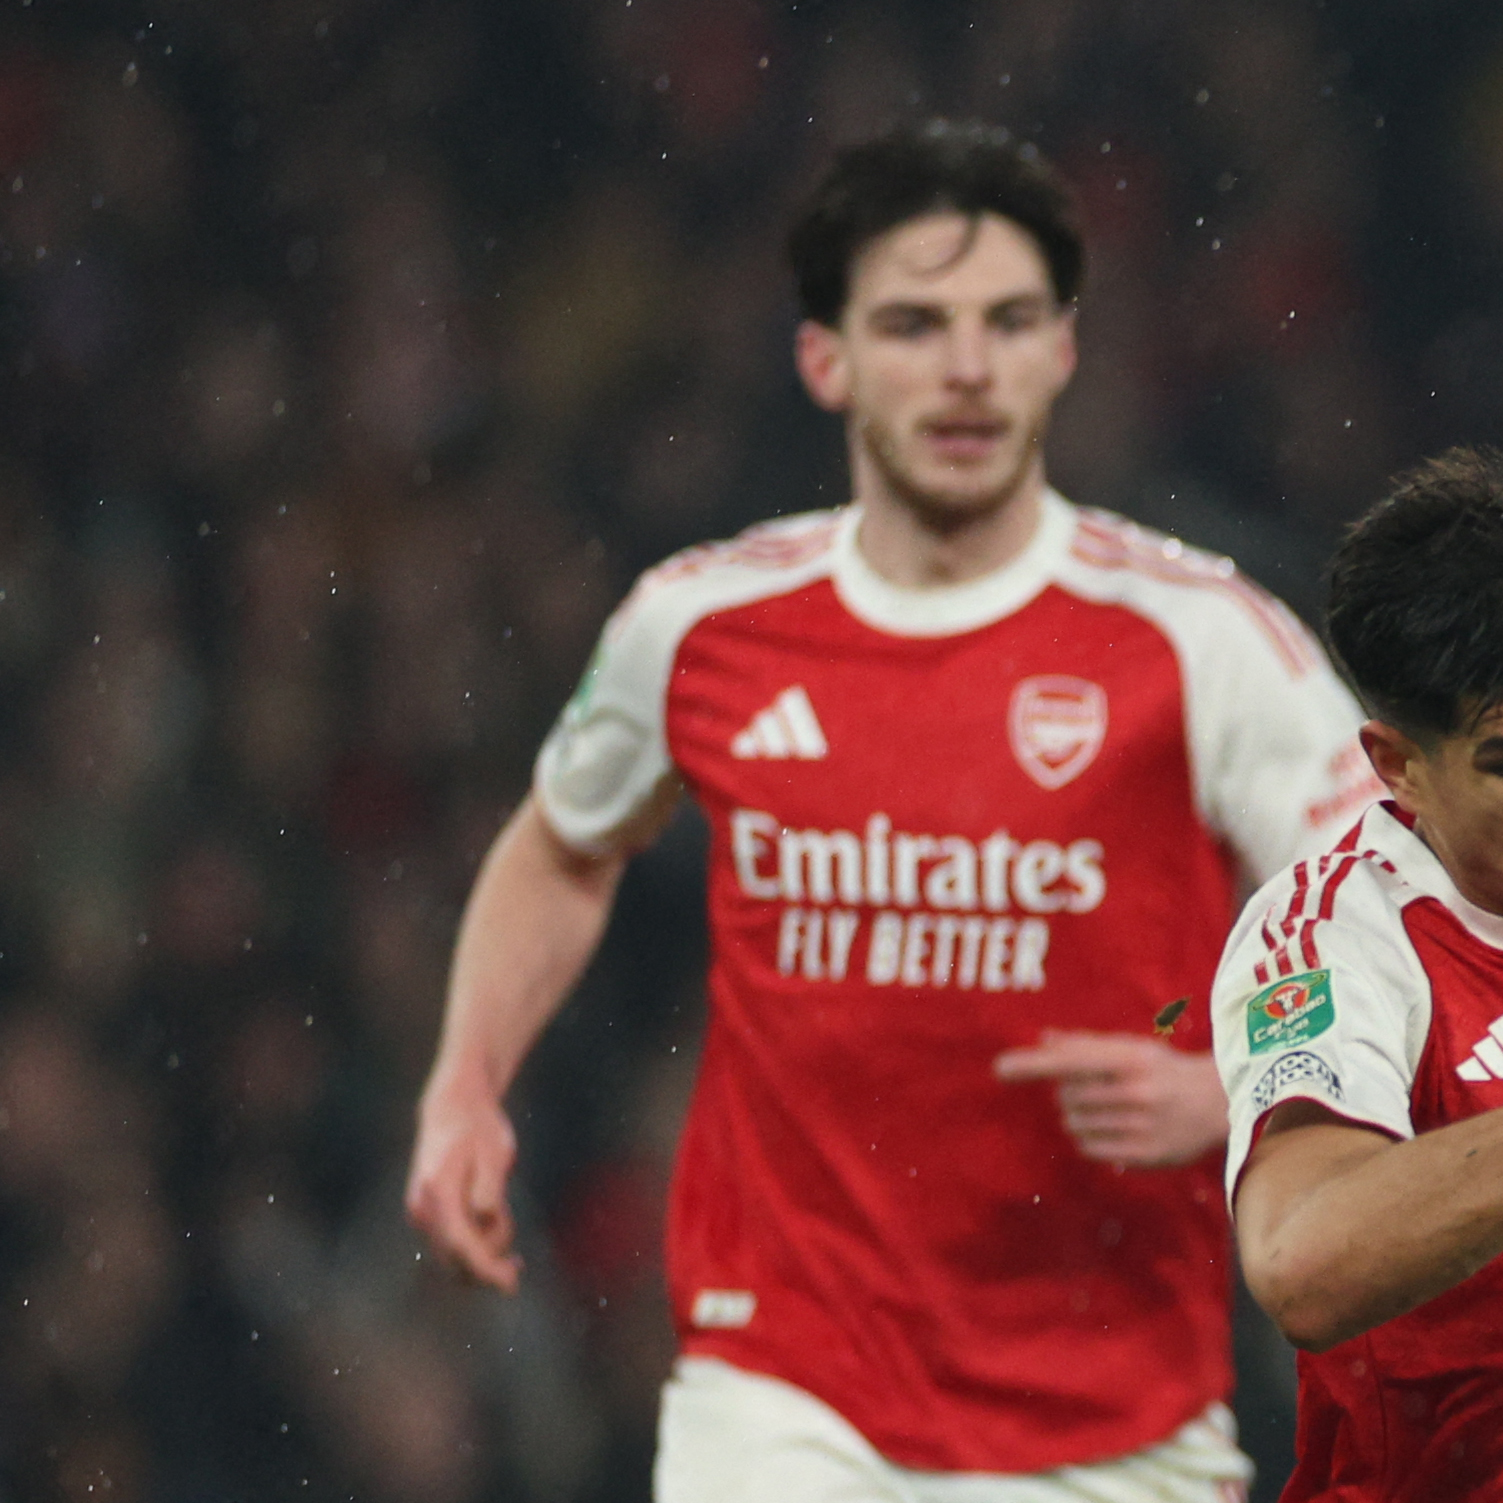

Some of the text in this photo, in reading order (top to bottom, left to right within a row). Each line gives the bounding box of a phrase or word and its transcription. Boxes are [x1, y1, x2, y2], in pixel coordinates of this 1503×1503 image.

[730, 806, 1106, 914] Emirates
[777, 906, 1049, 992] FLY BETTER
